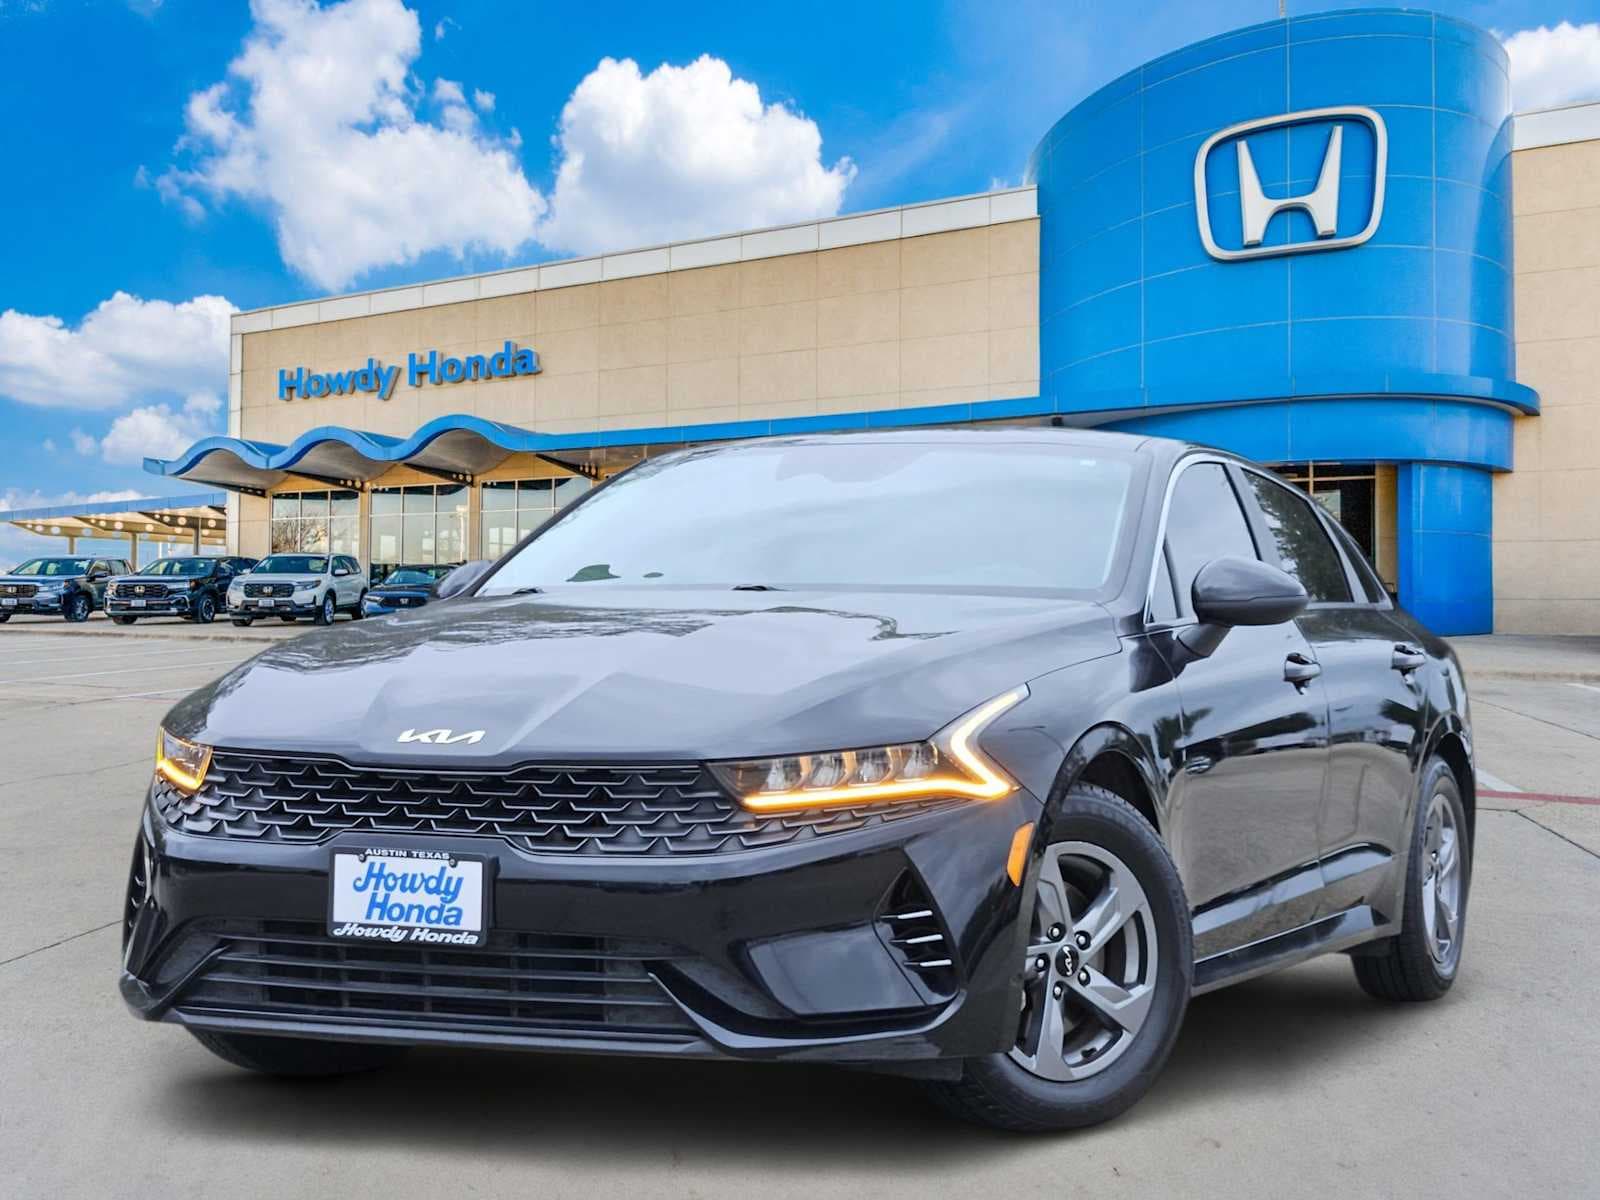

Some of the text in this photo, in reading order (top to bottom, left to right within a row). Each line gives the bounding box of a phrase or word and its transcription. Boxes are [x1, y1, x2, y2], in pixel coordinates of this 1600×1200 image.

[278, 340, 542, 401] Howdy Honda
[365, 848, 450, 860] AUSTIN TEXAS
[352, 861, 464, 904] Howdy
[365, 892, 463, 926] Honda
[333, 922, 479, 945] Howdy Honda
